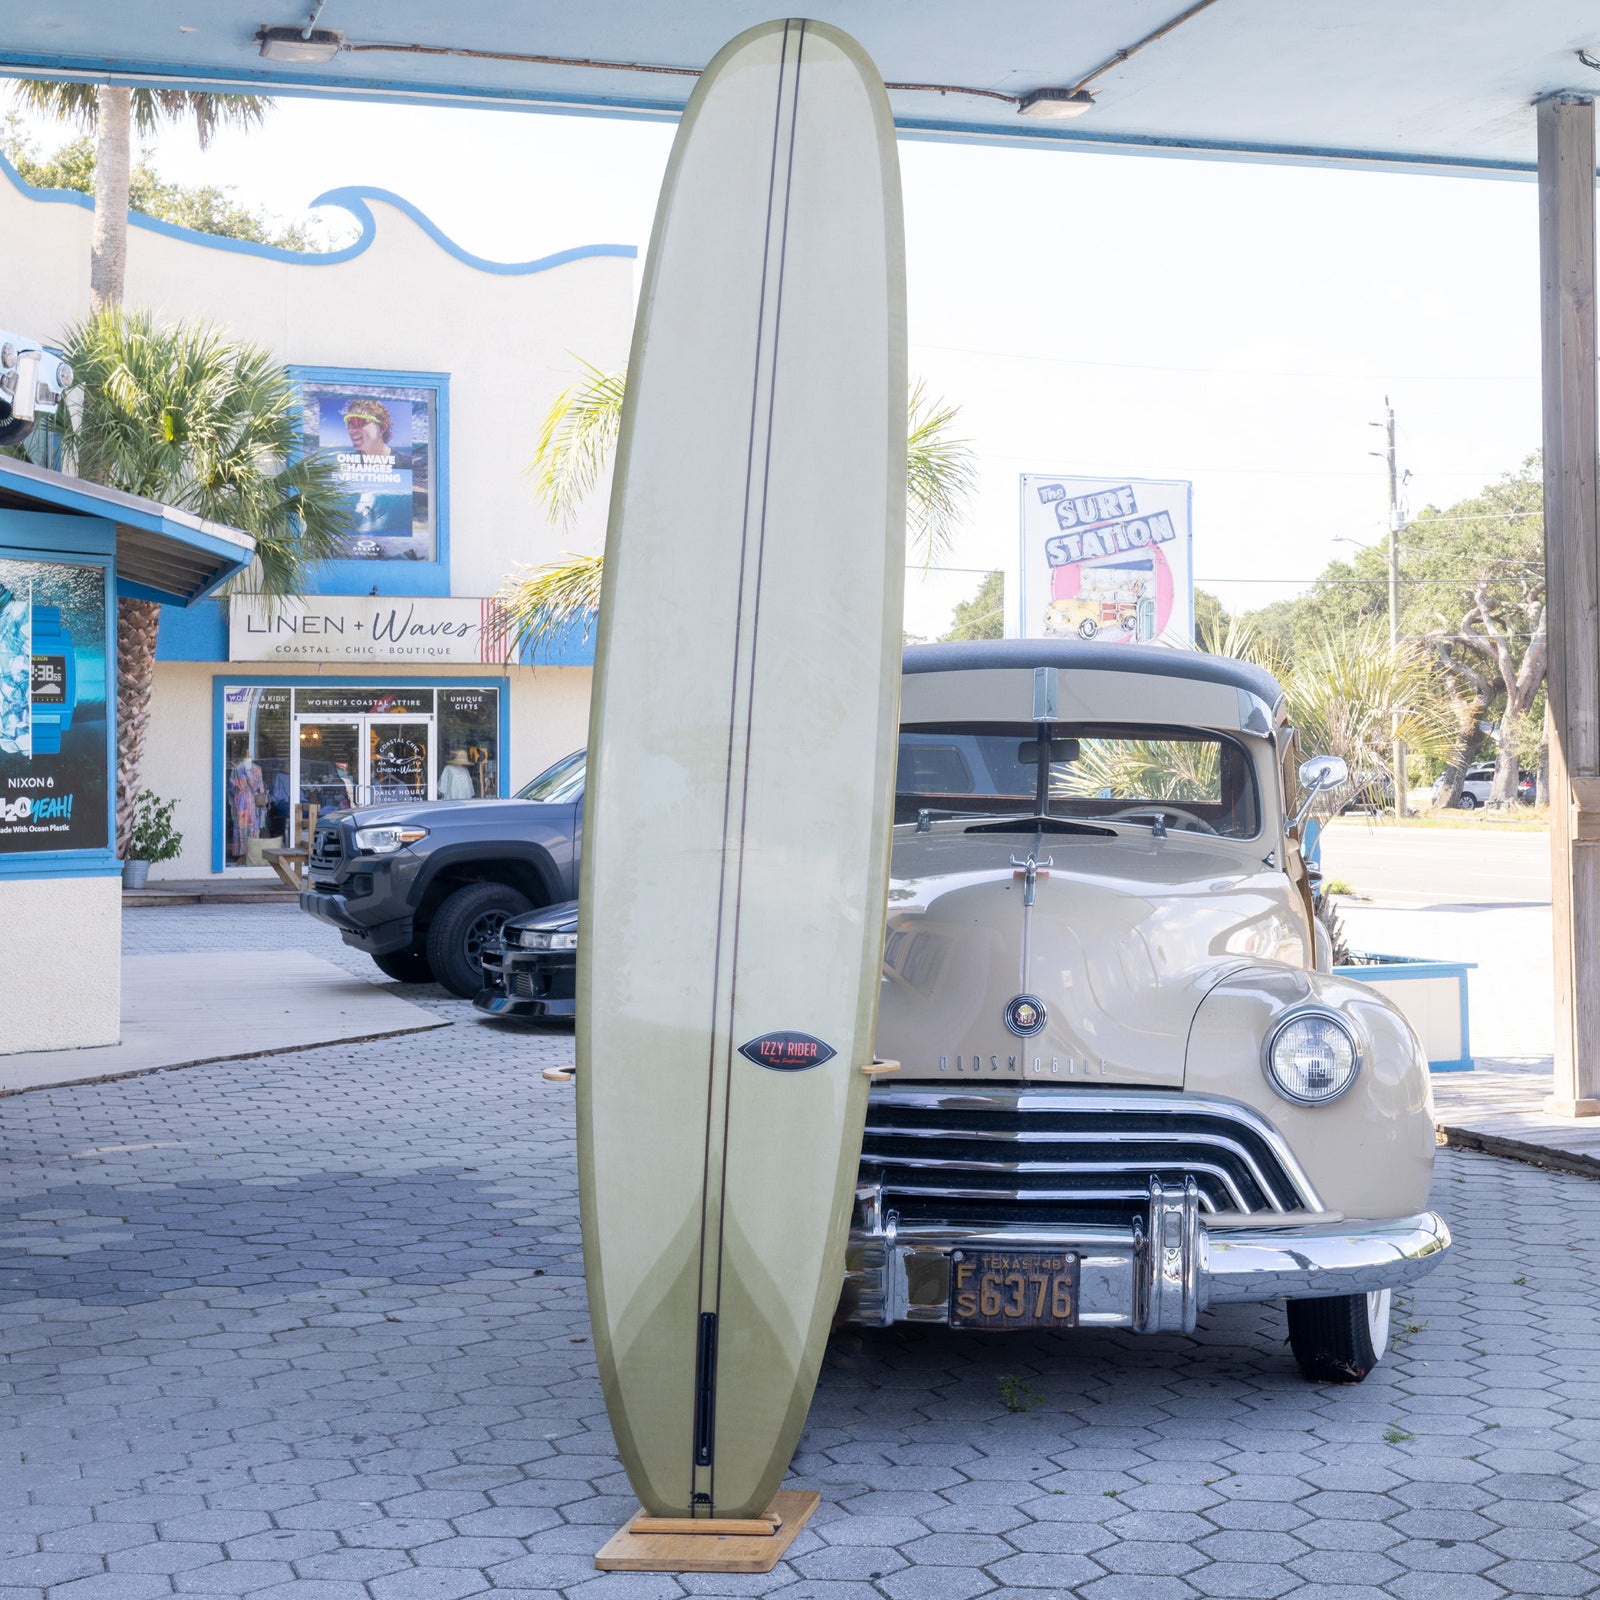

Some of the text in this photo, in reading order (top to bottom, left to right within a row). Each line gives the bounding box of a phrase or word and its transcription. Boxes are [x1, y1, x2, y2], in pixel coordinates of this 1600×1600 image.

[336, 453, 396, 465] ONE WAVE
[340, 463, 393, 474] CHANGES
[331, 472, 401, 483] EVERYTHING
[1040, 485, 1065, 501] The
[1057, 487, 1137, 530] SURF
[1046, 513, 1174, 566] STATION
[247, 614, 344, 634] LINEN
[372, 603, 477, 643] Waves
[275, 645, 452, 656] COASTAL CHIC BOUTIQUE
[351, 699, 388, 707] COASTAL
[379, 738, 420, 753] COASTAL CHIC
[8, 777, 45, 788] NIXON
[30, 793, 74, 824] YEAH!
[12, 825, 29, 833] With
[50, 823, 70, 832] Plastic
[760, 1041, 818, 1057] IZZY RIDER
[980, 1273, 1073, 1319] 6376
